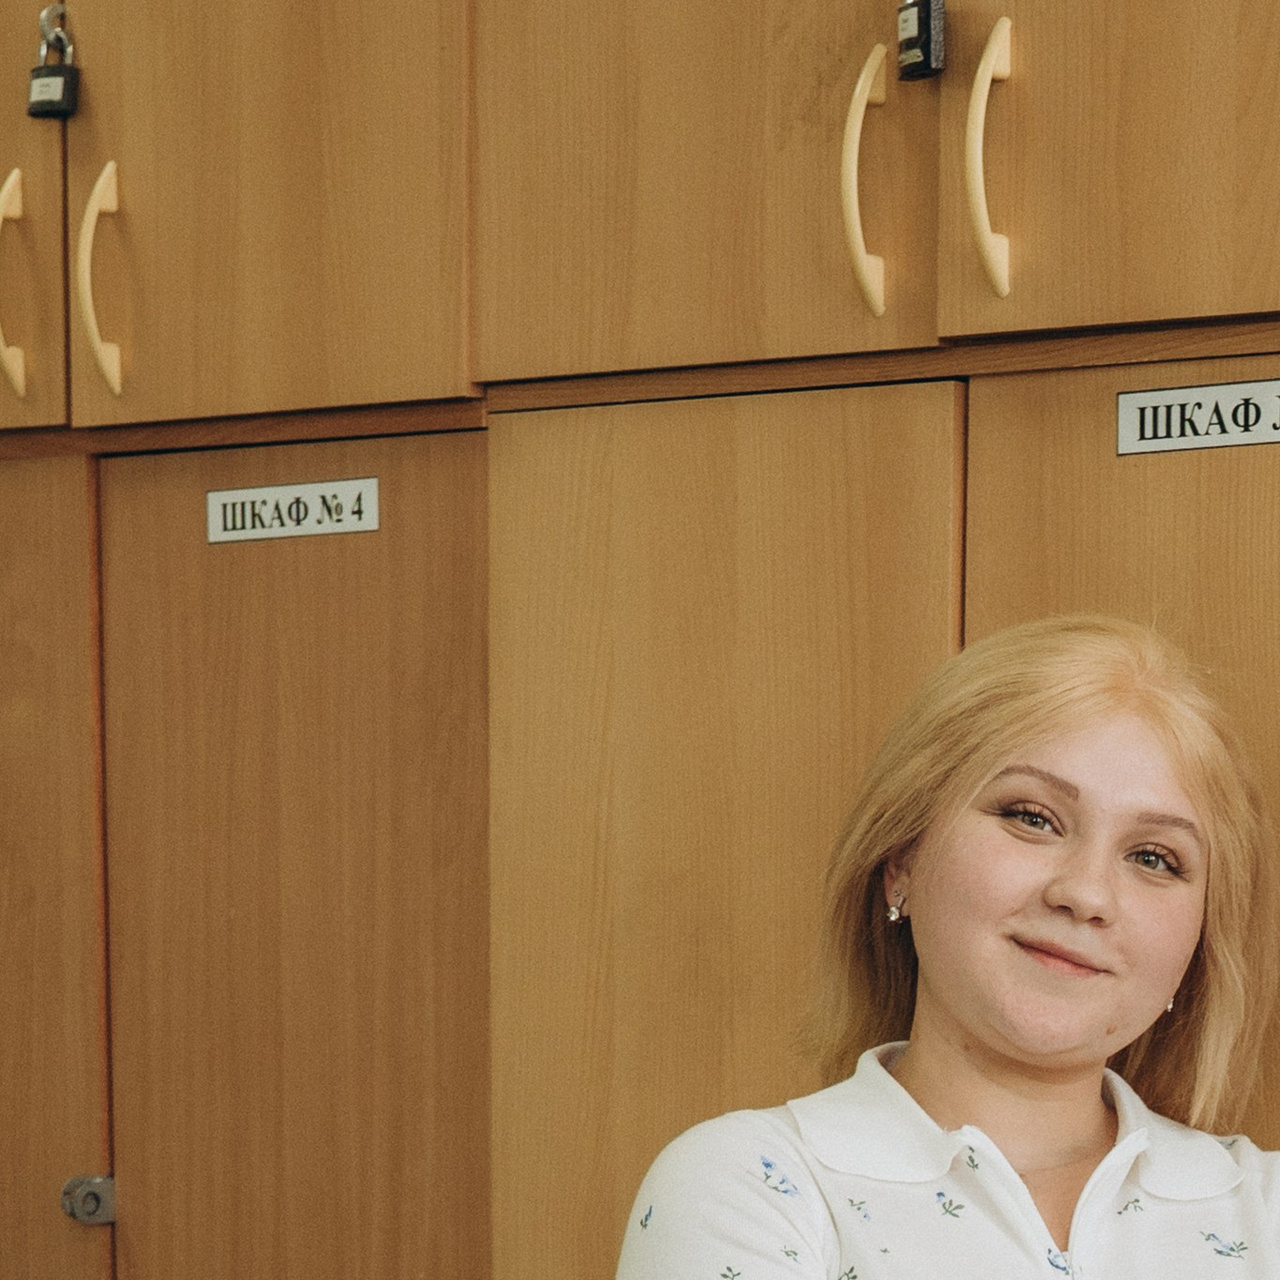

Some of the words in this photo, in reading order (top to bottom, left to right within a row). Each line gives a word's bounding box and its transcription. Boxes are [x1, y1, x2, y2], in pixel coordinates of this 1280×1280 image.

[1137, 397, 1262, 441] ШКАФ
[221, 497, 309, 532] ШКАФ
[316, 493, 344, 525] №
[351, 490, 364, 522] 4
